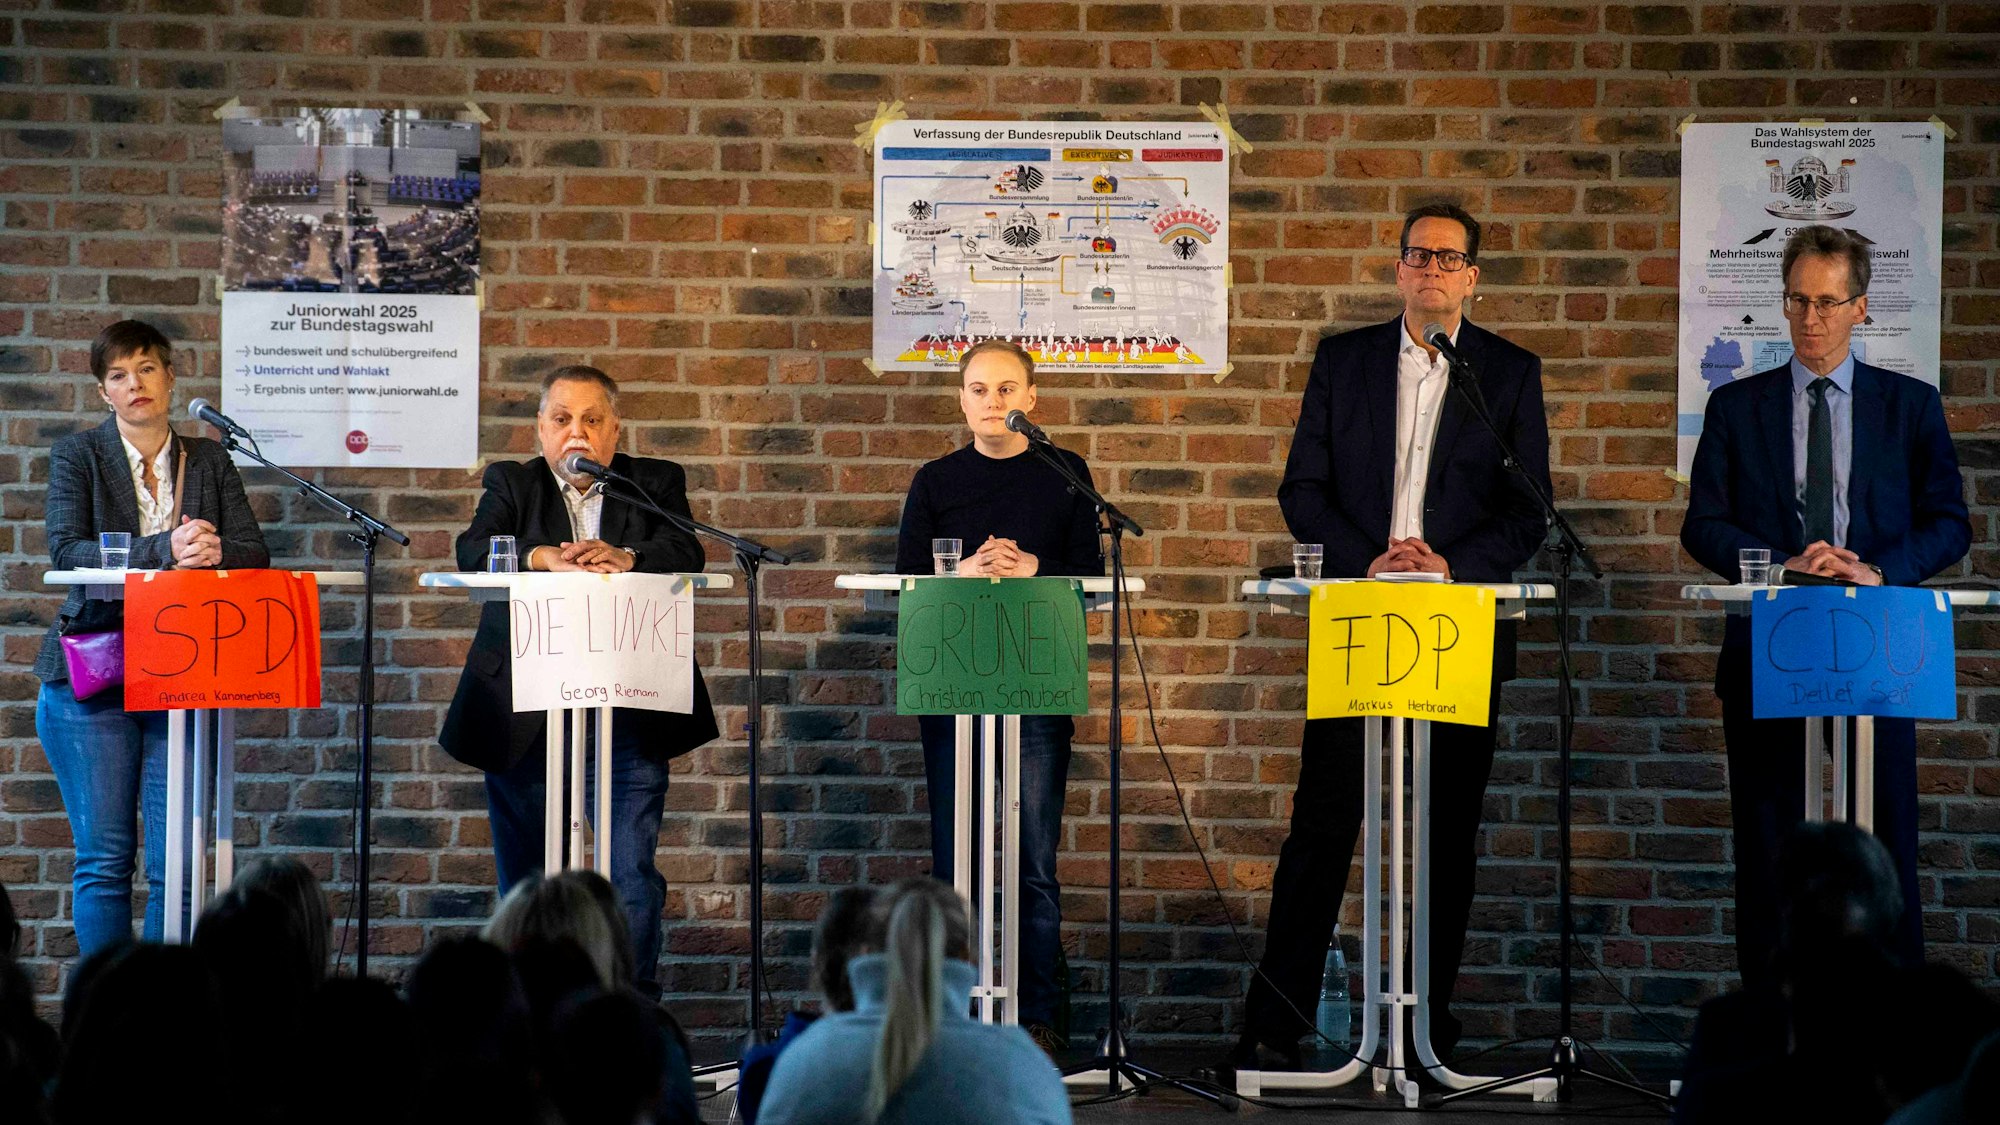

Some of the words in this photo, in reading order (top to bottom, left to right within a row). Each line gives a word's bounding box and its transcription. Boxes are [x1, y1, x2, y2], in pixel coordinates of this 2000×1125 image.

[913, 128, 981, 141] Verfassung
[984, 129, 1005, 139] der
[1008, 130, 1102, 141] Bundesrepublik
[1106, 130, 1181, 140] Deutschland
[1755, 128, 1777, 137] Das
[1780, 128, 1849, 138] Wahlsystem
[1852, 128, 1872, 137] der
[1751, 139, 1845, 149] Bundestagswahl
[1849, 139, 1876, 148] 2025
[1709, 249, 1784, 259] Mehrheitswa
[287, 303, 375, 317] Juniorwahl
[380, 305, 417, 318] 2025
[270, 320, 296, 331] zur
[301, 318, 433, 334] Bundestagswahl
[253, 346, 322, 357] bundesweit
[326, 346, 348, 357] und
[351, 347, 458, 359] schulübergreifend
[254, 365, 314, 376] Unterricht
[317, 365, 340, 376] und
[342, 366, 390, 376] Wahlakt
[254, 384, 306, 396] Ergebnis
[309, 386, 344, 395] unter:
[347, 386, 459, 397] www.juniorwahl.de
[511, 597, 565, 658] DIE
[587, 594, 689, 658] LINKE
[141, 597, 298, 677] SPD
[901, 594, 1081, 677] GRÜNEN
[1768, 606, 1925, 676] CDU
[1331, 613, 1459, 690] FDP
[159, 691, 206, 704] Andrea
[214, 690, 281, 703] Kanonenberg
[560, 681, 608, 702] Georg
[615, 683, 659, 698] Riemann
[903, 683, 984, 710] Christian
[995, 681, 1080, 709] Schubert
[1787, 681, 1854, 705] Detlef
[1868, 680, 1914, 705] Seif
[1348, 700, 1393, 713] Markus
[1408, 700, 1456, 714] Herbrand
